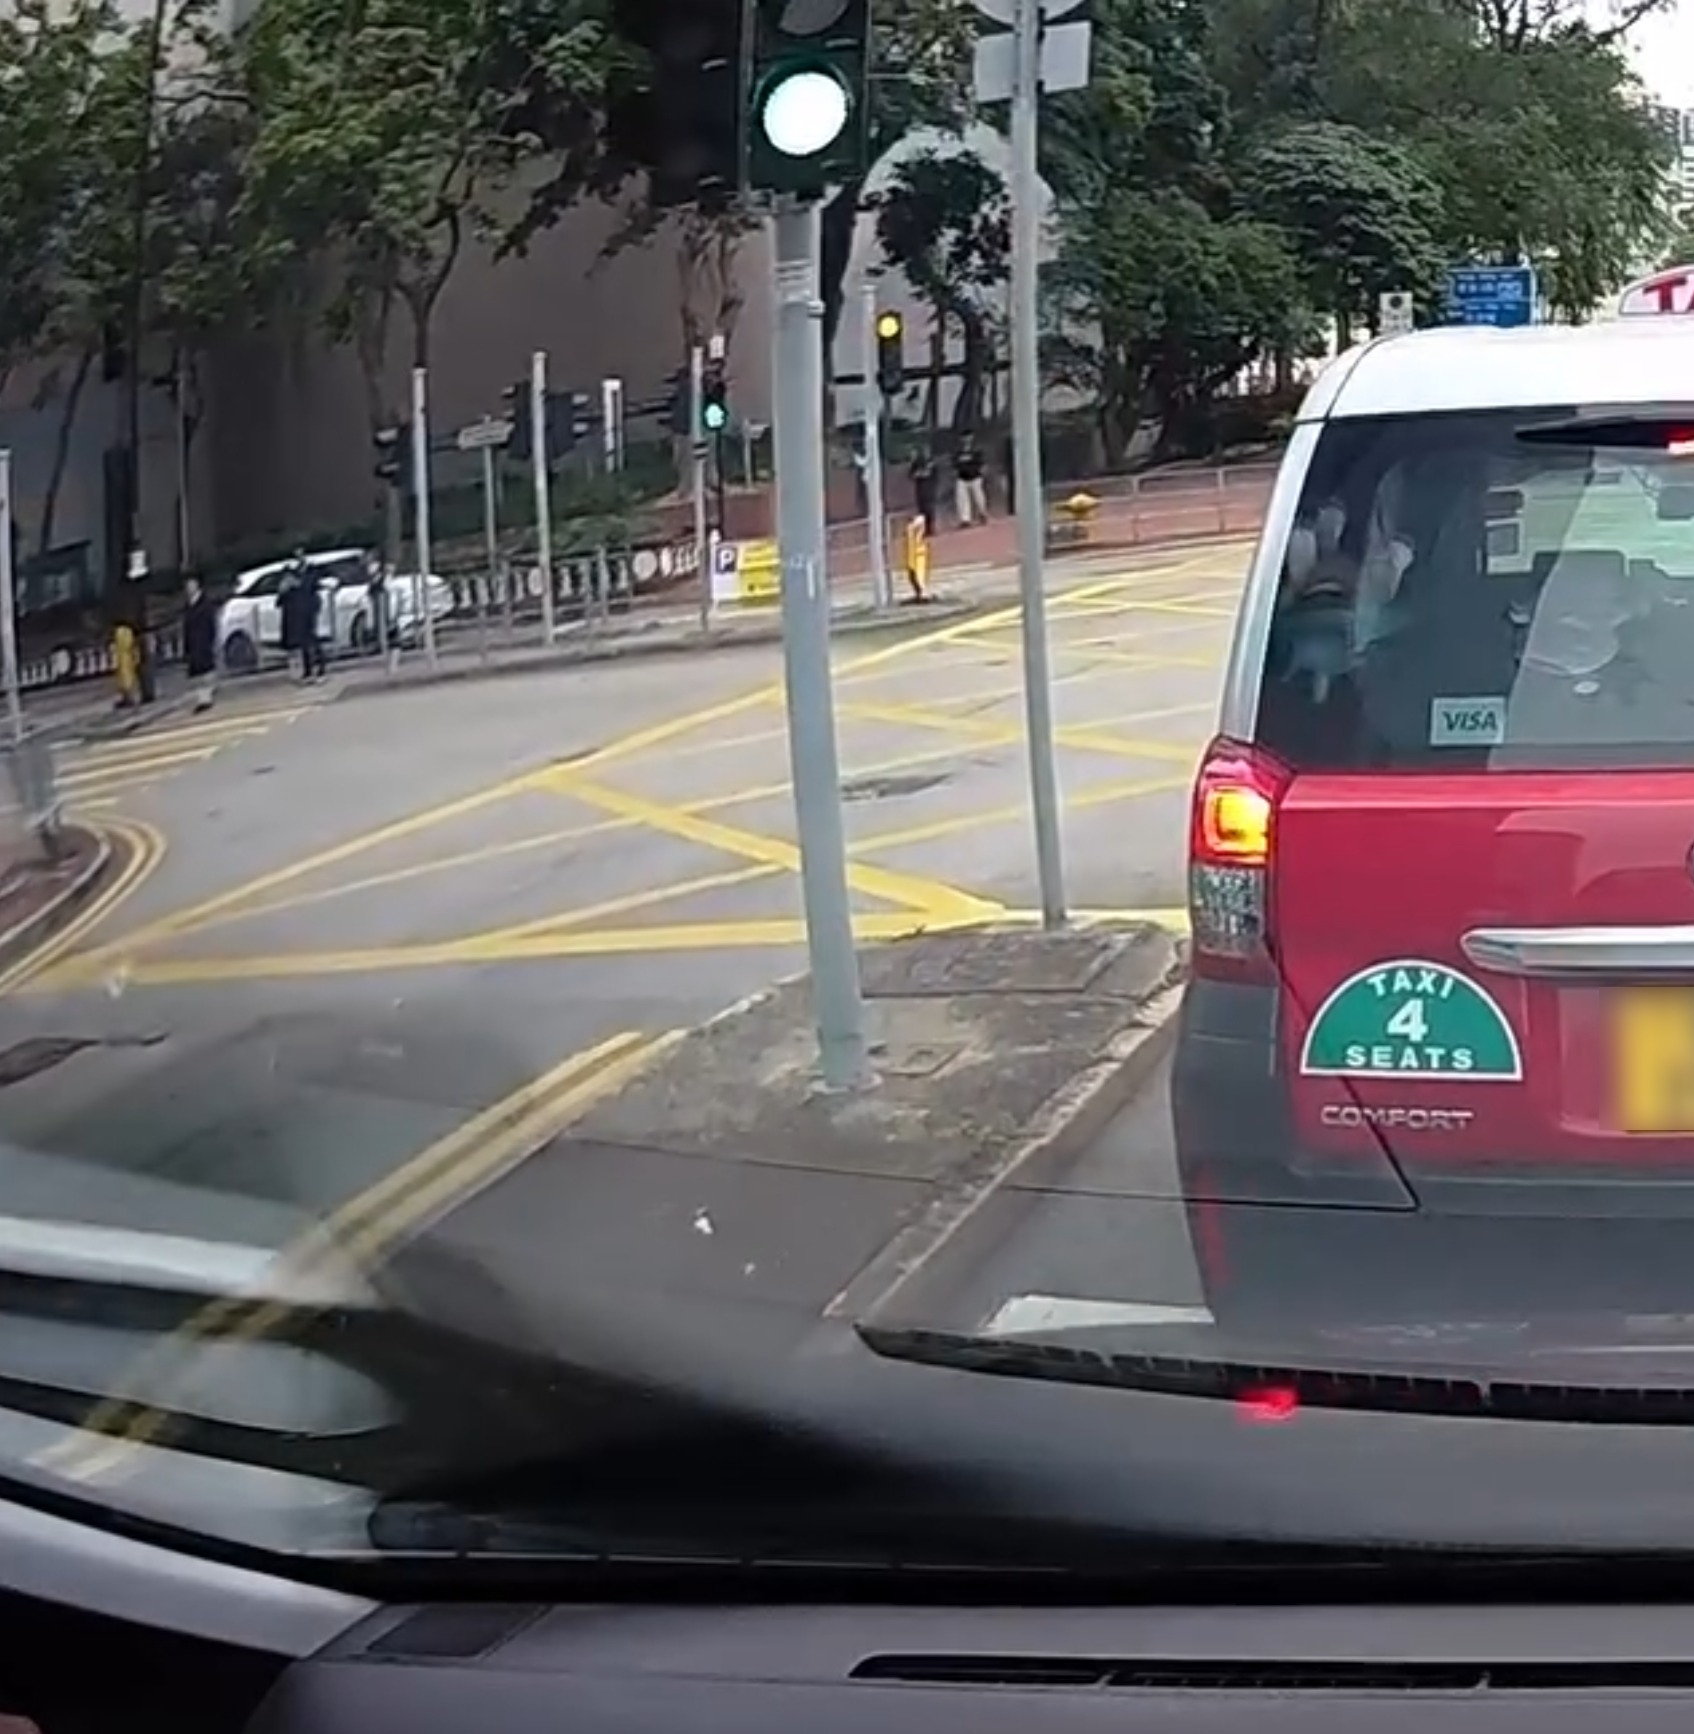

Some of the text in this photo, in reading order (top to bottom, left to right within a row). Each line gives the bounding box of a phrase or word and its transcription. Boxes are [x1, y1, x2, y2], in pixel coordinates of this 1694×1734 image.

[720, 549, 735, 571] P
[1441, 710, 1498, 731] VISA
[1367, 969, 1454, 999] TAXI
[1386, 997, 1429, 1042] 4
[1345, 1046, 1474, 1070] SEATS
[1320, 1106, 1474, 1130] COMFORT
